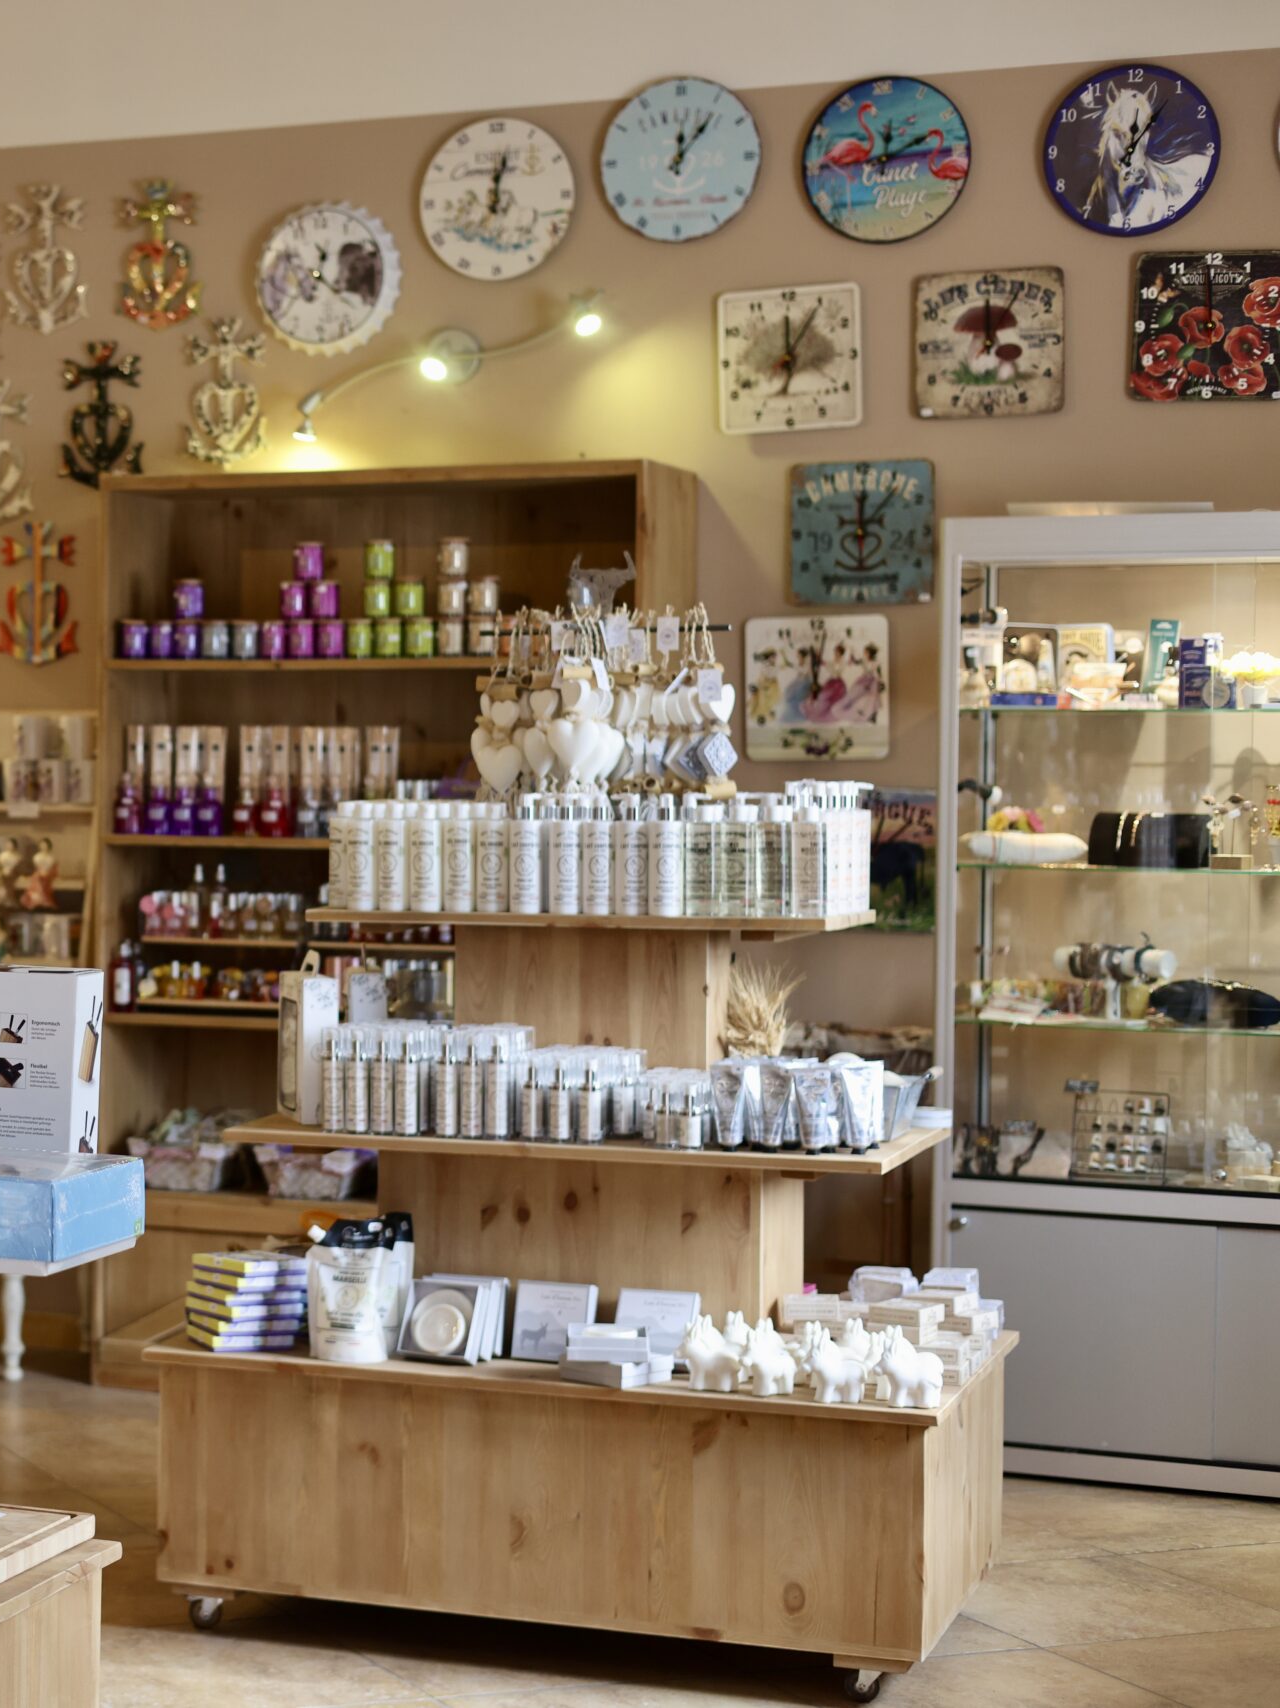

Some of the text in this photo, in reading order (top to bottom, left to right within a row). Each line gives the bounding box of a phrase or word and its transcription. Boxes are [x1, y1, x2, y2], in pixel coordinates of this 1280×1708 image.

[1128, 69, 1144, 82] 12
[1175, 80, 1183, 94] 1
[1061, 109, 1077, 123] 10
[1197, 105, 1207, 119] 2
[1048, 145, 1058, 159] 9
[1206, 142, 1215, 156] 3
[1056, 179, 1065, 193] 8
[1194, 177, 1205, 191] 4
[1082, 205, 1091, 219] 7
[1166, 205, 1176, 219] 5
[1122, 218, 1131, 232] 6
[1205, 253, 1223, 265] 12
[1169, 262, 1185, 274] 11
[1243, 261, 1252, 273] 1
[1141, 286, 1158, 299] 10
[1268, 286, 1279, 298] 2
[1134, 320, 1146, 333] 9
[1142, 354, 1153, 367] 8
[1264, 353, 1276, 365] 4
[1167, 378, 1178, 390] 7
[1237, 378, 1248, 389] 5
[1201, 387, 1212, 399] 6
[31, 1020, 61, 1028] Ergonomisch
